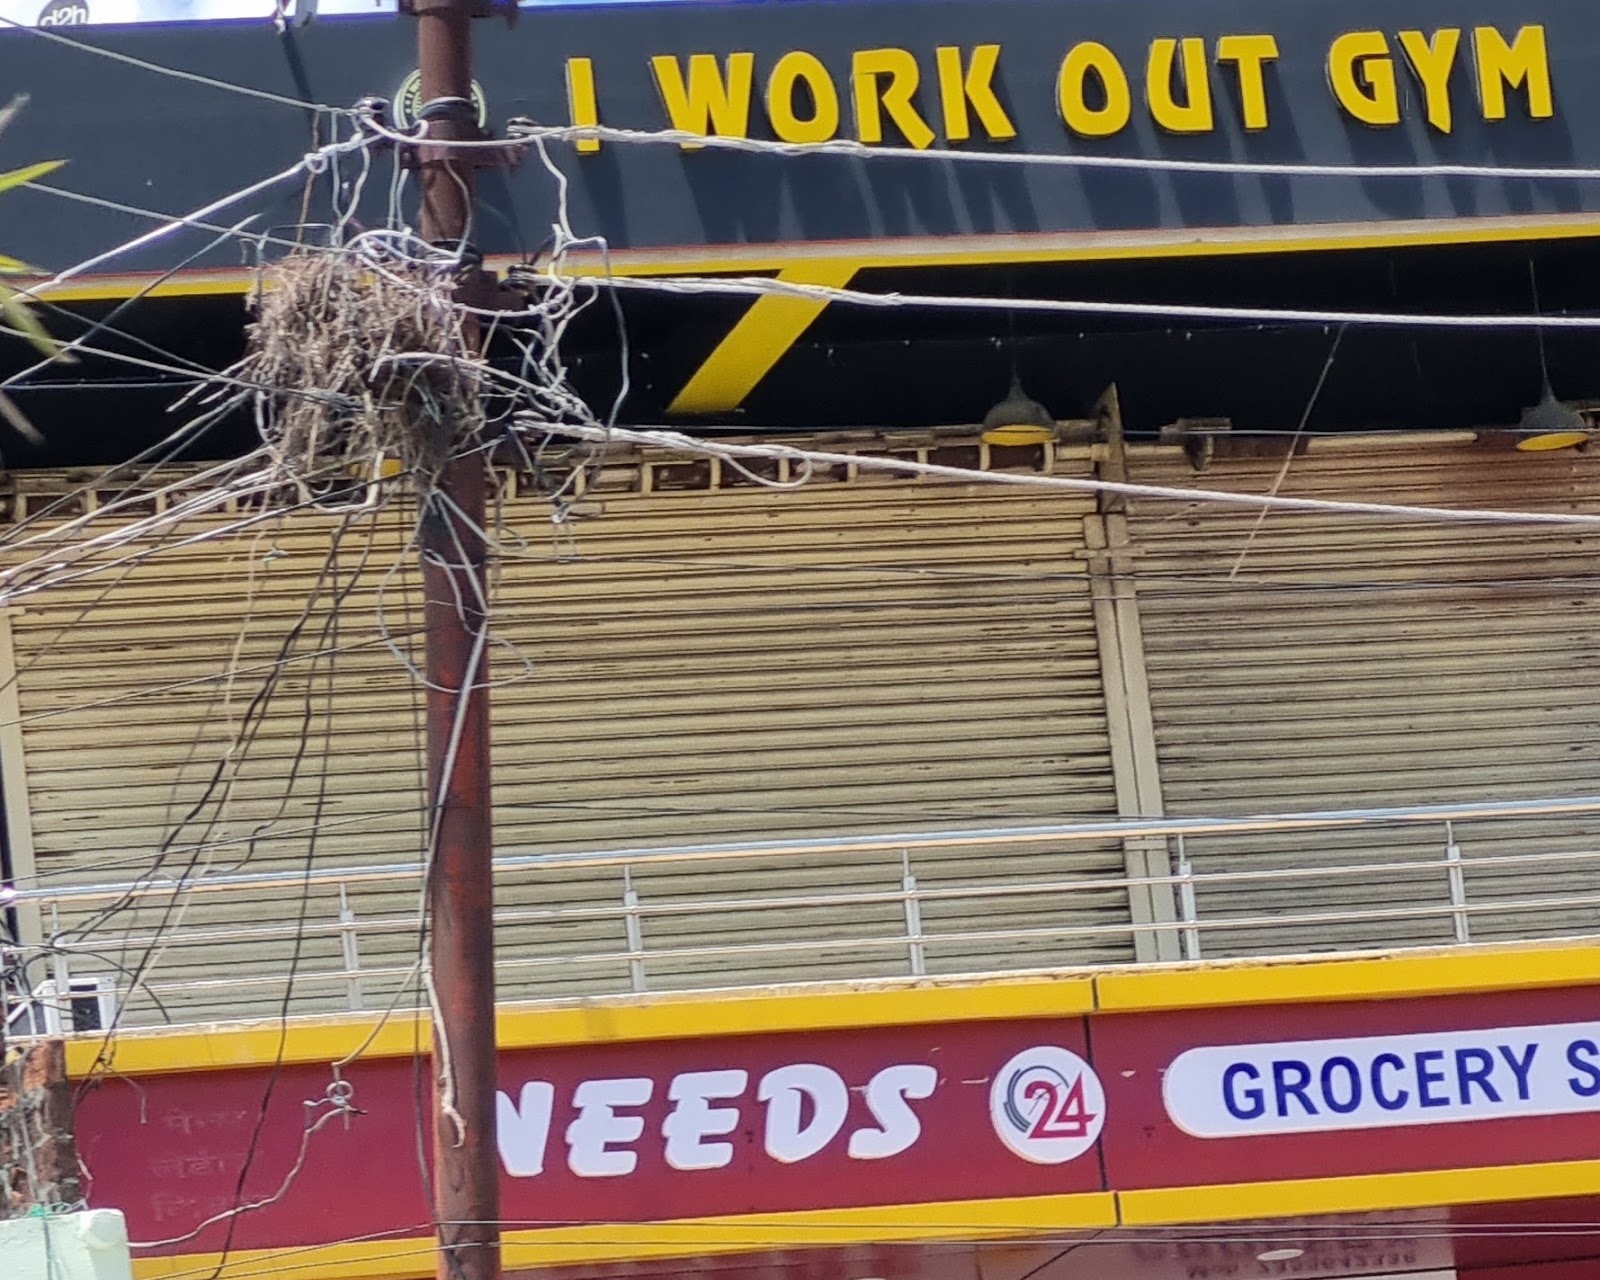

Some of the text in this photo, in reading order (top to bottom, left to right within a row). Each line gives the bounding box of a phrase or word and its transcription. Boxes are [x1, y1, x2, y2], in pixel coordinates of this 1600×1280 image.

[565, 24, 1553, 153] I WORK OUT GYM
[496, 1063, 938, 1177] NEEDS
[1024, 1071, 1097, 1139] 24
[1222, 1043, 1539, 1120] GROCERY
